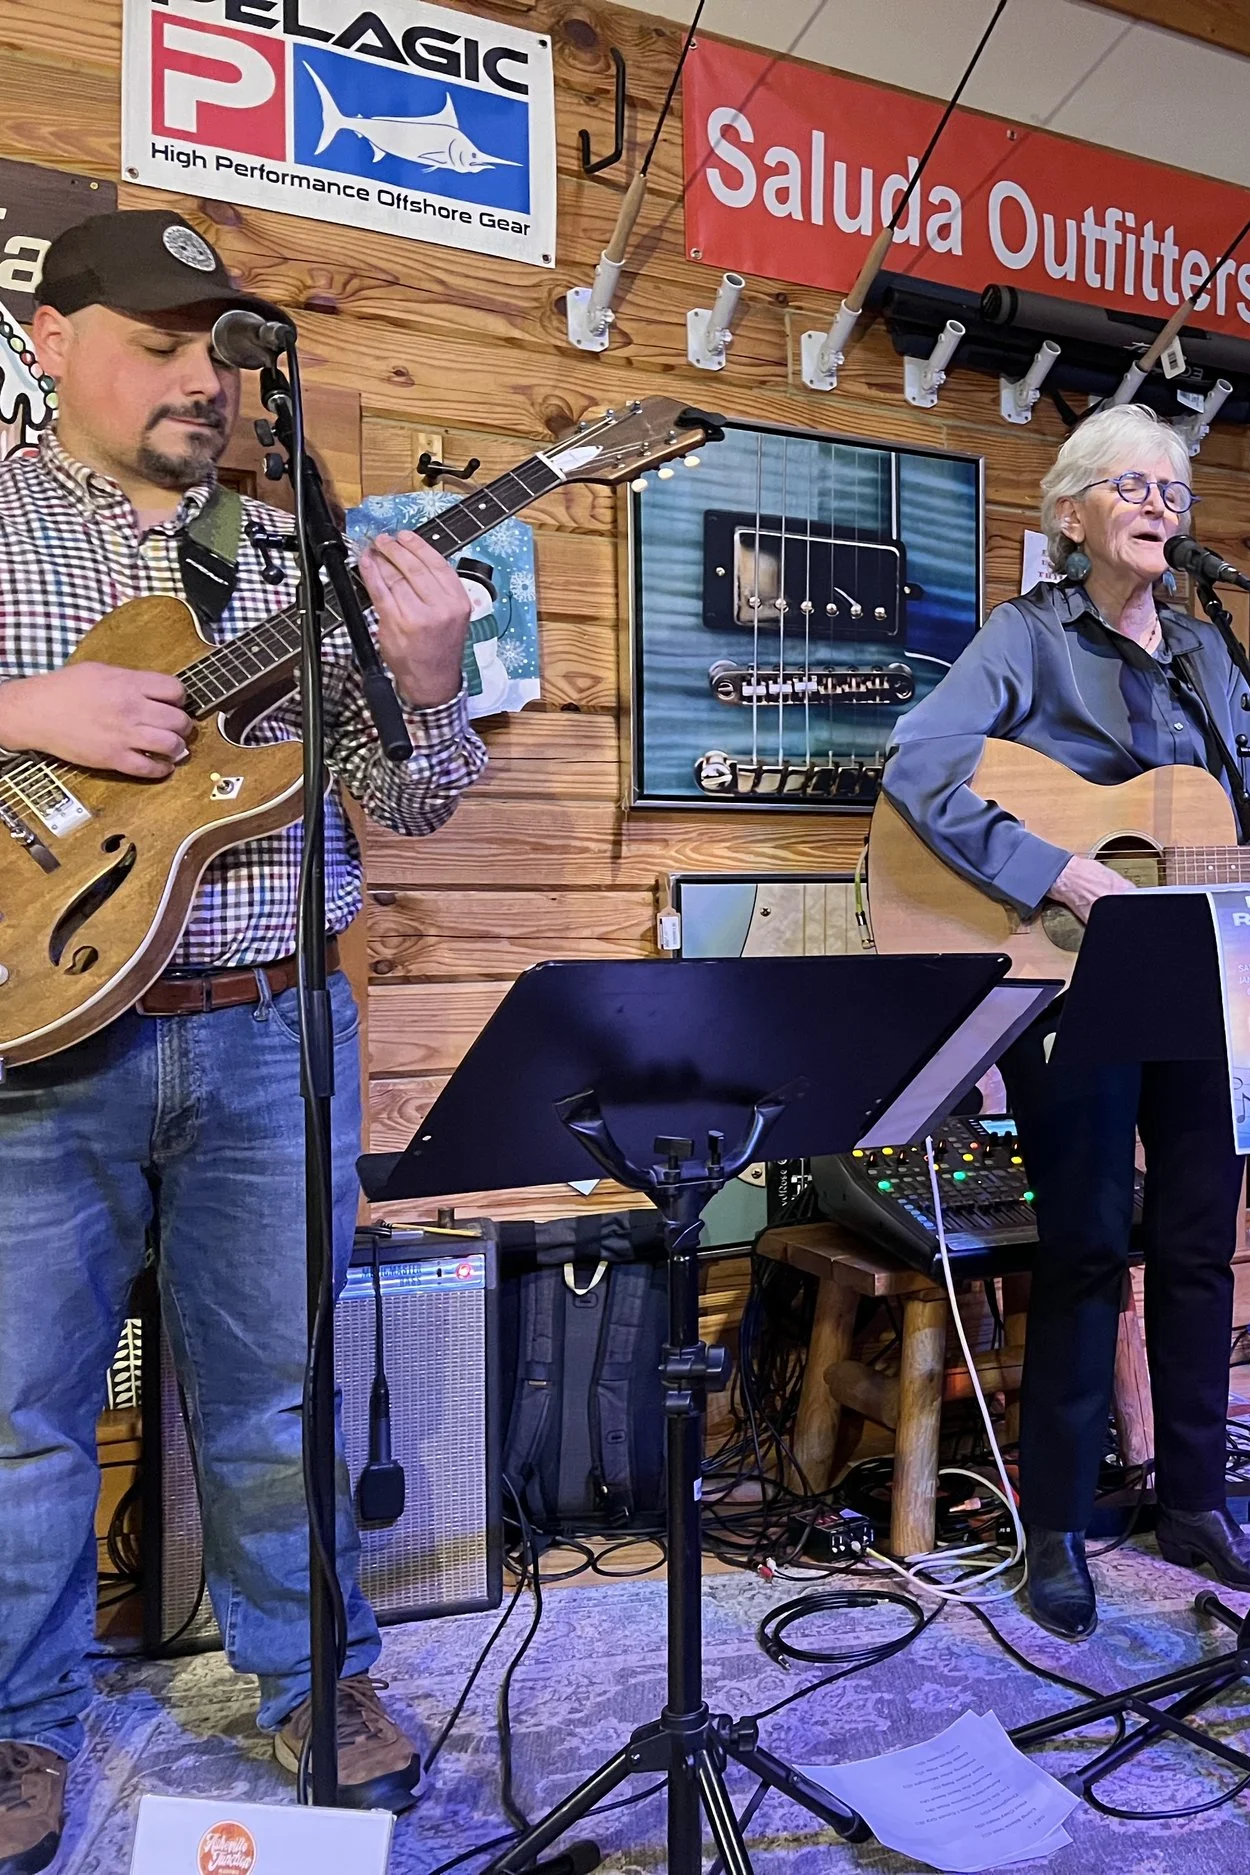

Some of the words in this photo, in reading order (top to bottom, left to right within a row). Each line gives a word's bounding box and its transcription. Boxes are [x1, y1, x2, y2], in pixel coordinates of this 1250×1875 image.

[150, 0, 530, 95] ELAGIC
[150, 141, 209, 171] High
[214, 155, 370, 203] Performance
[377, 187, 474, 226] Offshore
[478, 209, 532, 238] Gear
[704, 105, 964, 257] Saluda
[361, 1264, 422, 1278] MUICMASTER
[208, 1851, 252, 1871] Junction
